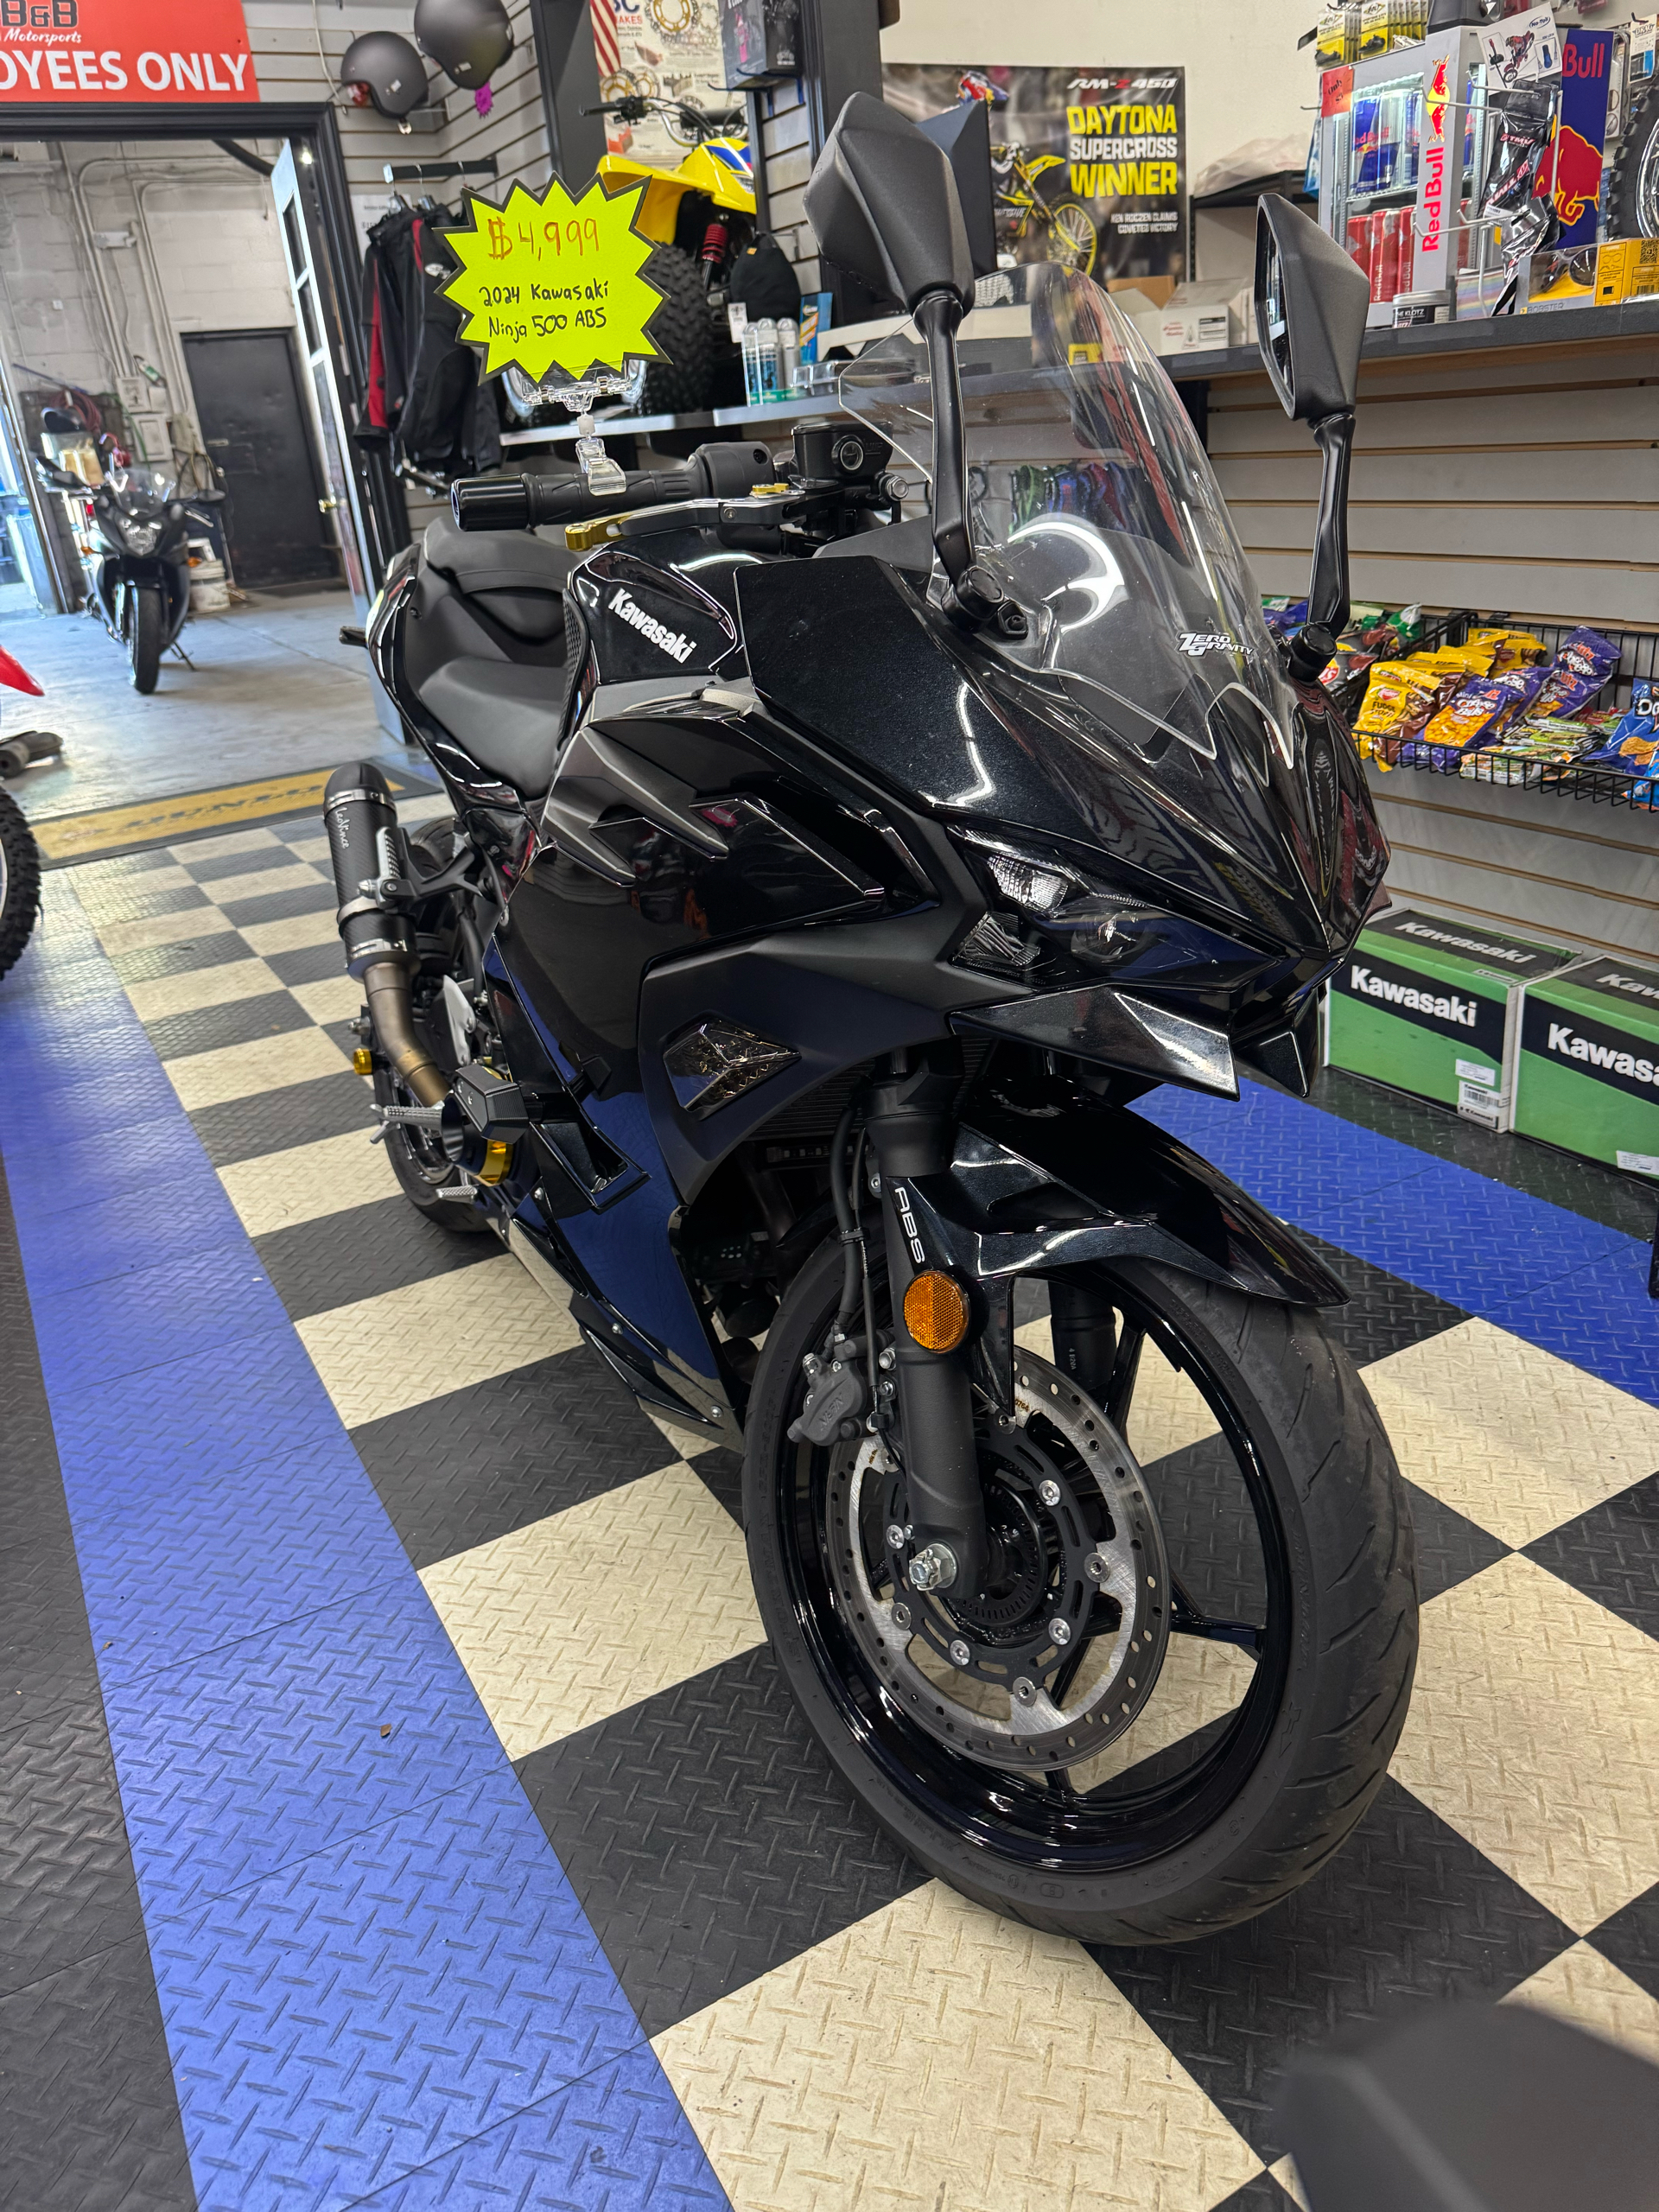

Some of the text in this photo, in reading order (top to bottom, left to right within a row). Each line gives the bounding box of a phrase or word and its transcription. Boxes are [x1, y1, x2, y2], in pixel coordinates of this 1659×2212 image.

[2, 0, 78, 28] B&B
[617, 16, 642, 24] AKES
[4, 28, 81, 46] Motorsports
[137, 52, 248, 92] ONLY
[1562, 43, 1605, 79] Bull
[1066, 104, 1178, 135] DAYTONA
[1070, 137, 1178, 160] SUPERCROSS
[1070, 162, 1178, 198] WINNER
[1422, 147, 1444, 251] Red Bull
[487, 217, 600, 261] $4,999
[479, 278, 608, 307] 2024 Kawasaki
[488, 307, 607, 344] Ninja 500 ABS
[607, 588, 697, 664] Kawasaki
[1179, 632, 1231, 652] ZERO
[1187, 642, 1255, 656] GRAVITY
[334, 807, 350, 849] LeoVince
[1395, 921, 1537, 964] Kawasaki
[1351, 964, 1478, 1027] Kawasaki
[895, 1186, 925, 1264] ABS
